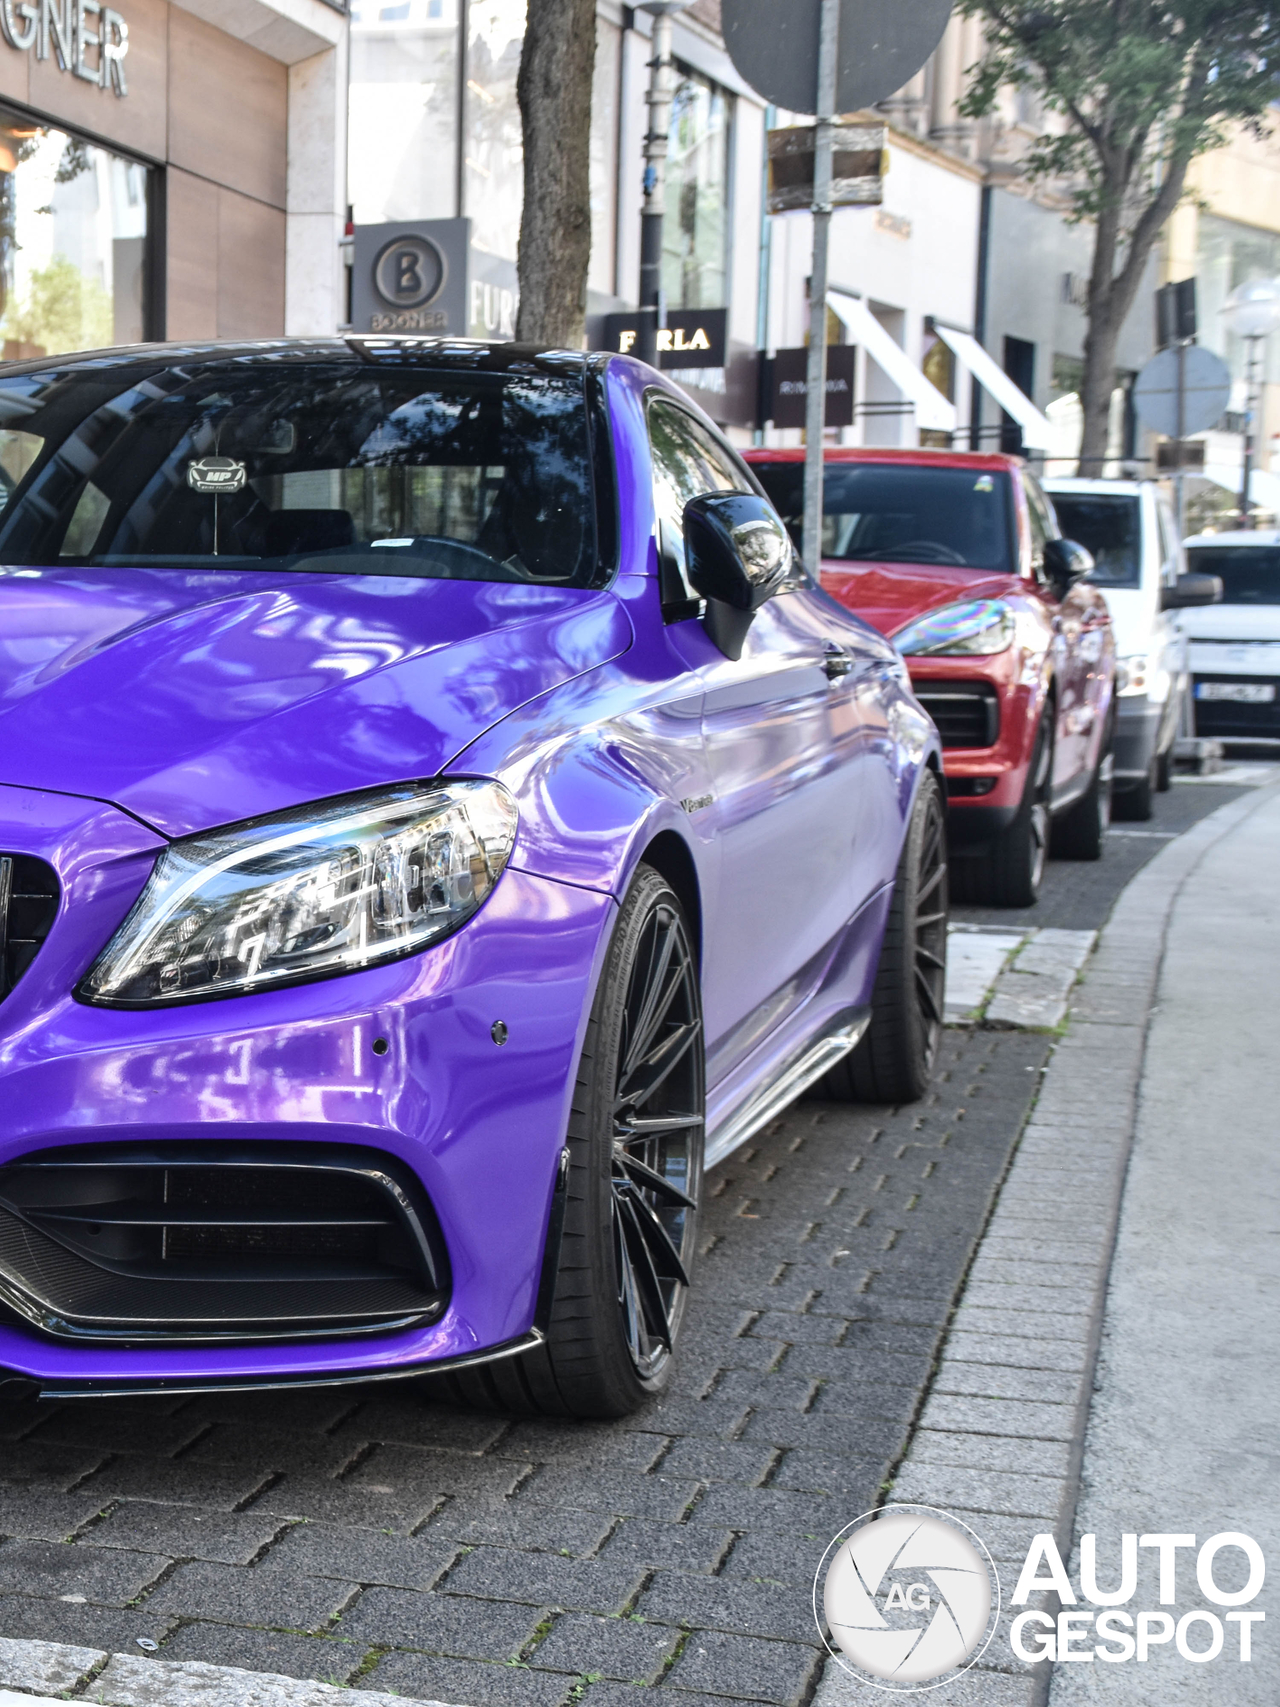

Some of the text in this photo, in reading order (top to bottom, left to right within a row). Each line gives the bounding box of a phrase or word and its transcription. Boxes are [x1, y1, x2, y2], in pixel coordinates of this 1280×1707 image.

[395, 251, 422, 293] B
[371, 311, 449, 331] BOGNER
[470, 280, 519, 338] FUR
[619, 328, 710, 353] FRLA
[206, 471, 232, 481] MP
